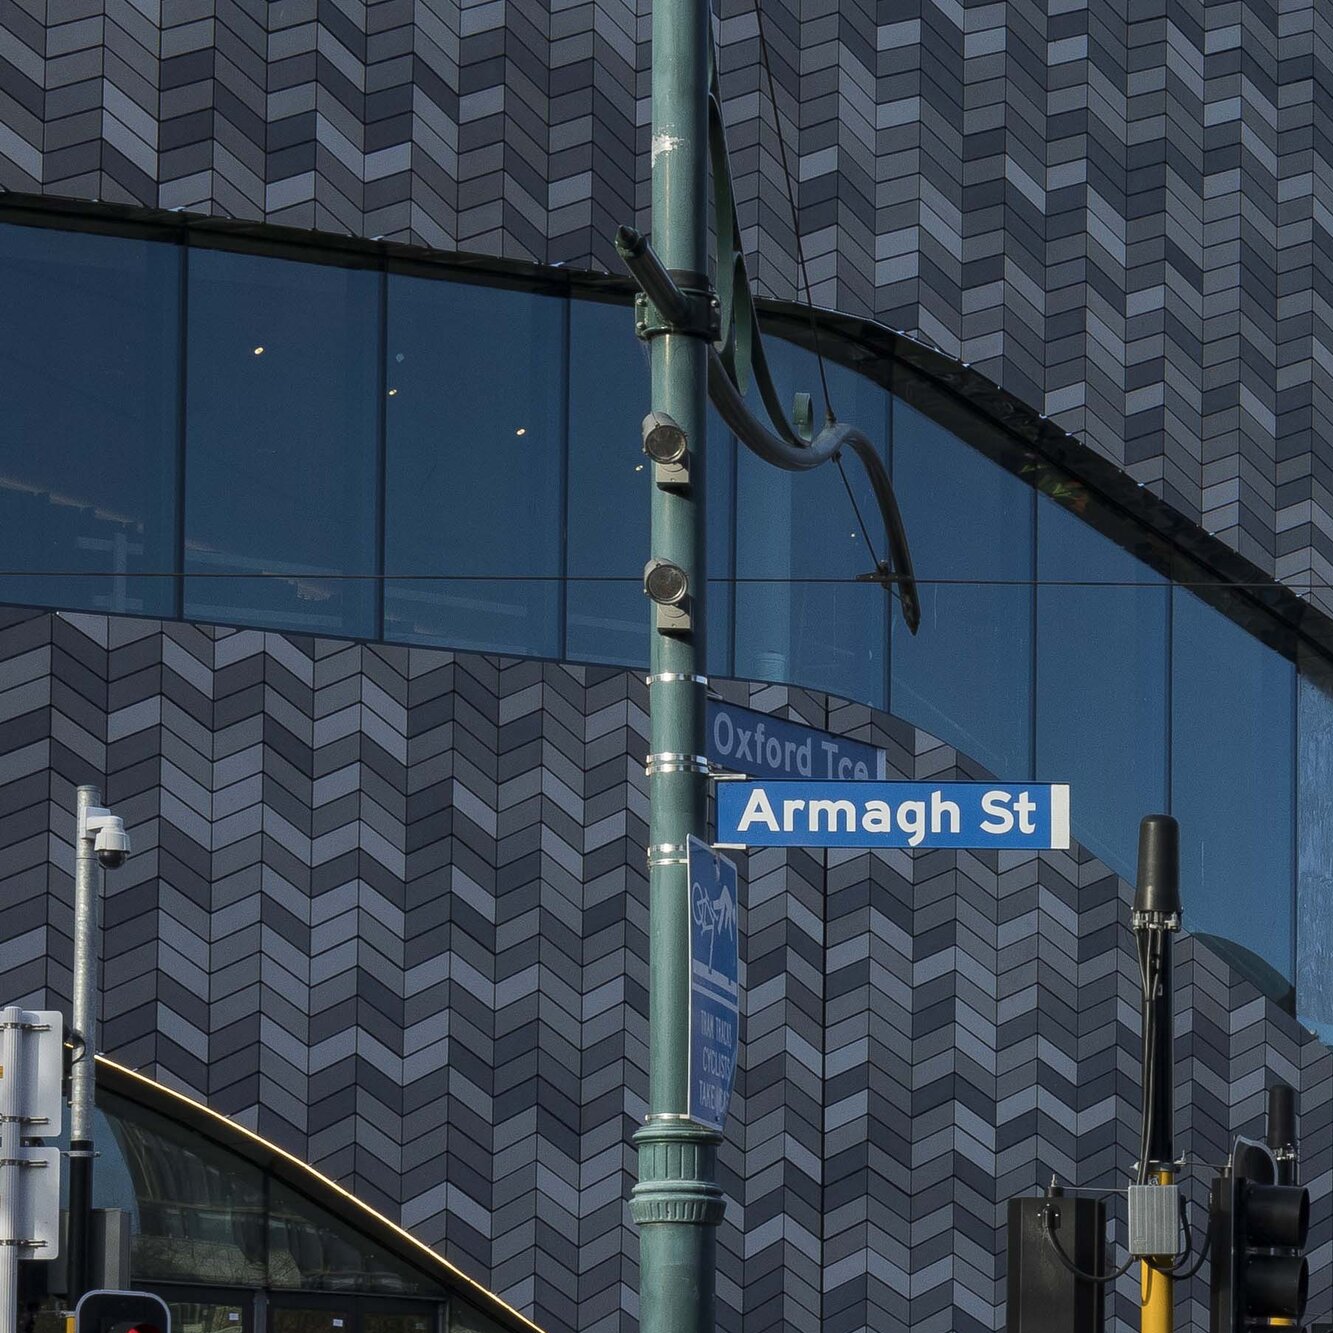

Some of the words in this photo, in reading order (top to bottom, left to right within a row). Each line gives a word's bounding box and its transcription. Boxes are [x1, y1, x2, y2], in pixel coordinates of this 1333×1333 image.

[713, 711, 812, 778] Oxford
[820, 741, 869, 780] Tce
[737, 788, 961, 847] Armagh
[979, 790, 1037, 835] St
[701, 1010, 714, 1039] TRAM
[715, 1017, 732, 1049] TRACKS
[702, 1046, 731, 1081] CYCLISTS
[699, 1079, 715, 1110] TAKE
